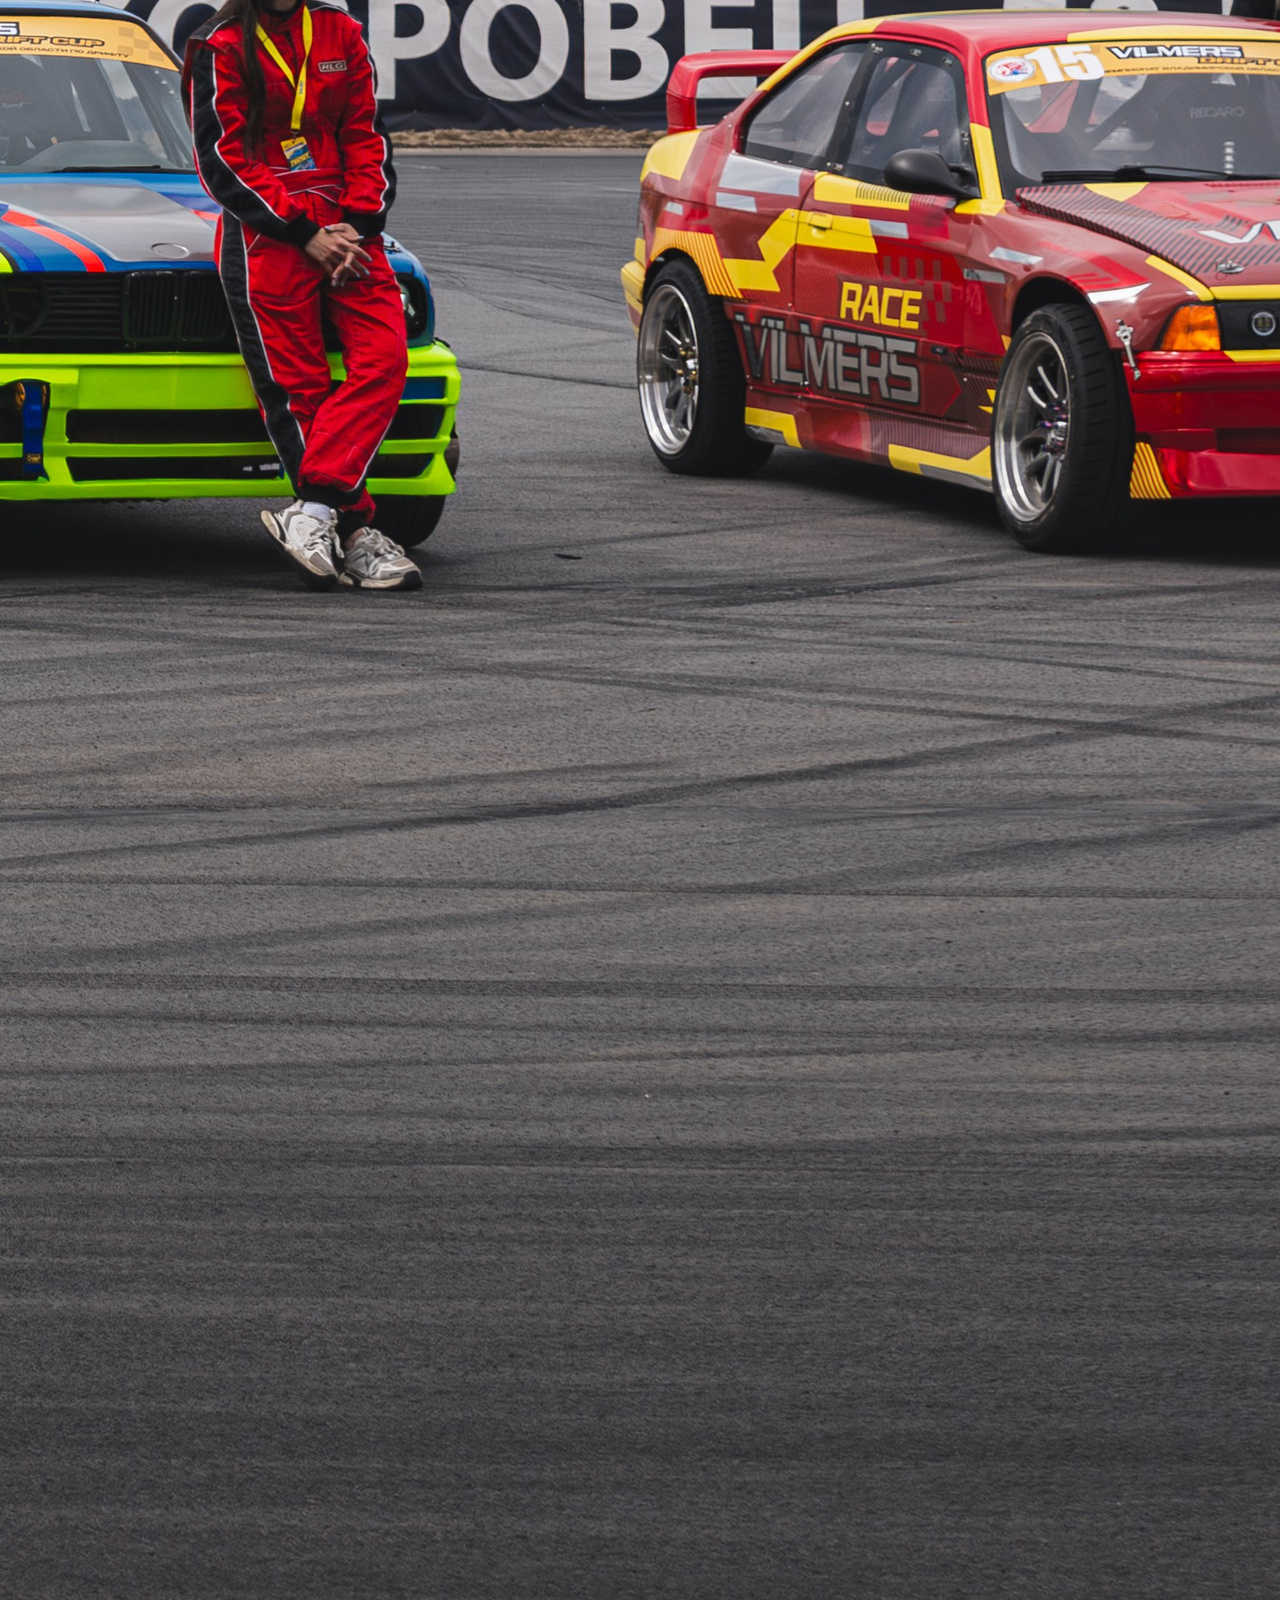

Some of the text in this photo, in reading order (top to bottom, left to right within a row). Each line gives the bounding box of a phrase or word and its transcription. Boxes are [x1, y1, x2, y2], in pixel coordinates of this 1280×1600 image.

[50, 36, 105, 48] CUP
[1108, 46, 1245, 59] VILMERS
[1024, 45, 1106, 83] 15
[1190, 105, 1245, 119] RECARO
[839, 281, 923, 330] RACE
[733, 312, 920, 405] VILMERS
